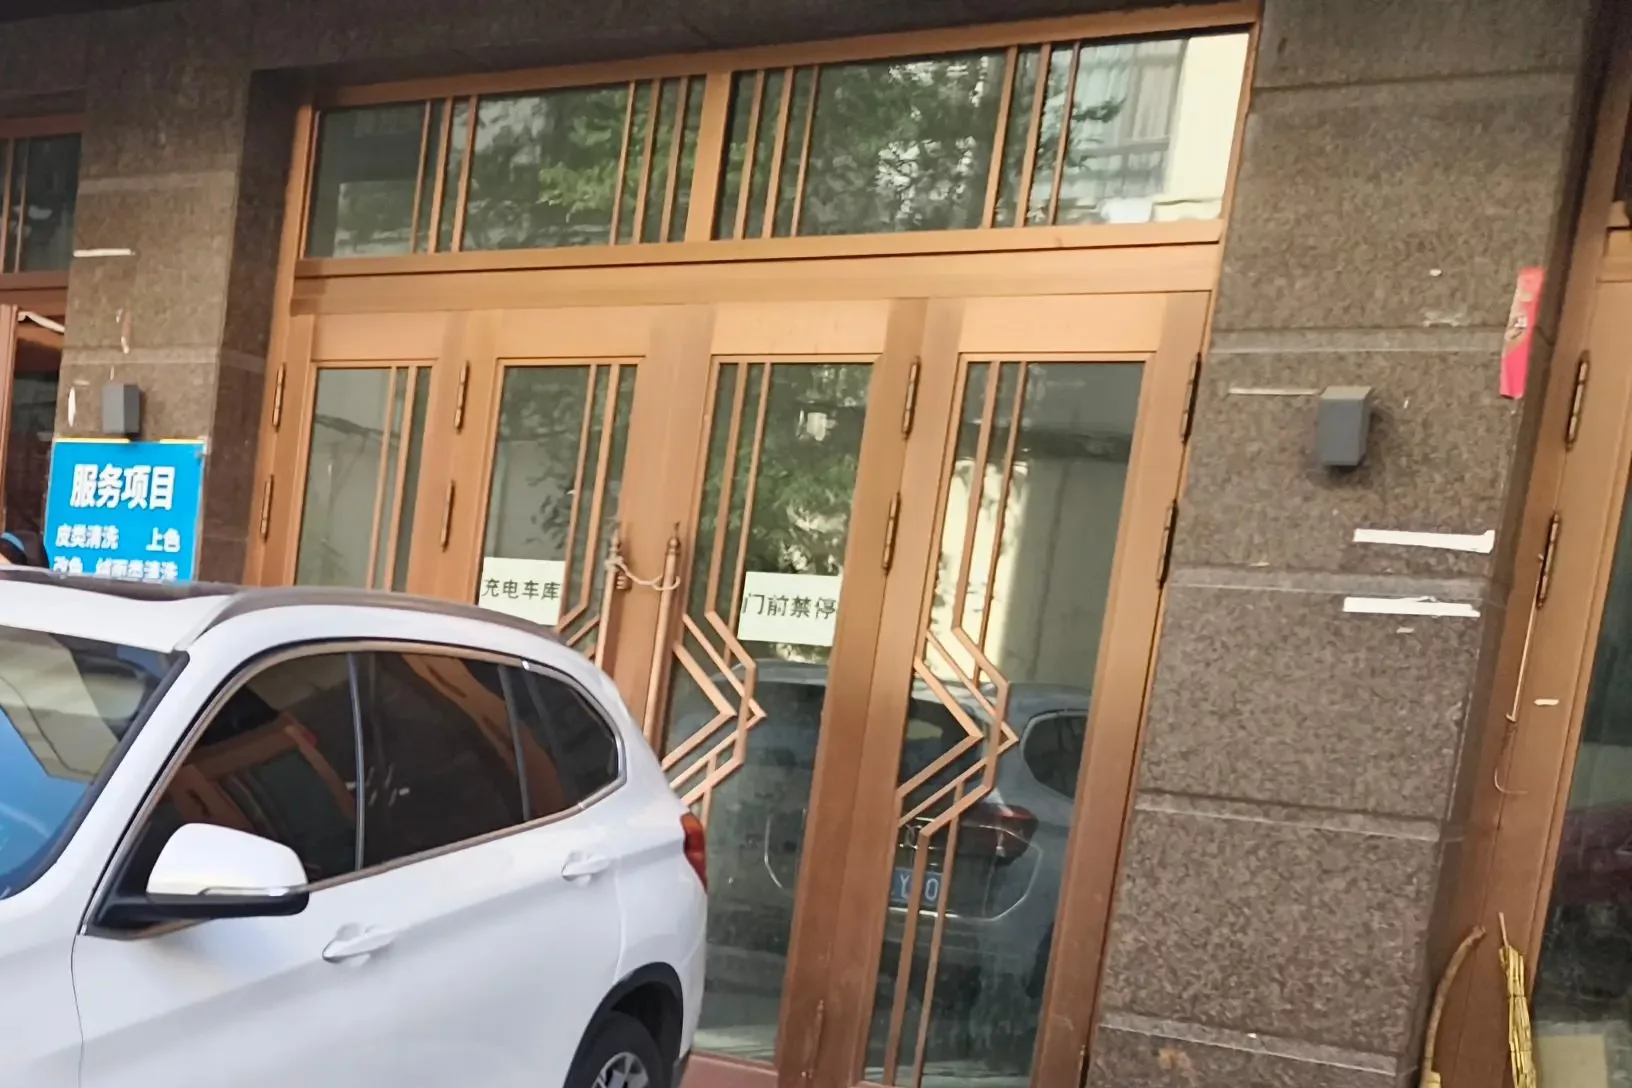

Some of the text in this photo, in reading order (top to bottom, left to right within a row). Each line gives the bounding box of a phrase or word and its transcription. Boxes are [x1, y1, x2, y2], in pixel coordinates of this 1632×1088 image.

[70, 463, 175, 510] 服务项目
[56, 523, 181, 552] 皮类清洗 上色
[481, 578, 561, 600] 充电车库
[742, 593, 837, 619] 门前禁停
